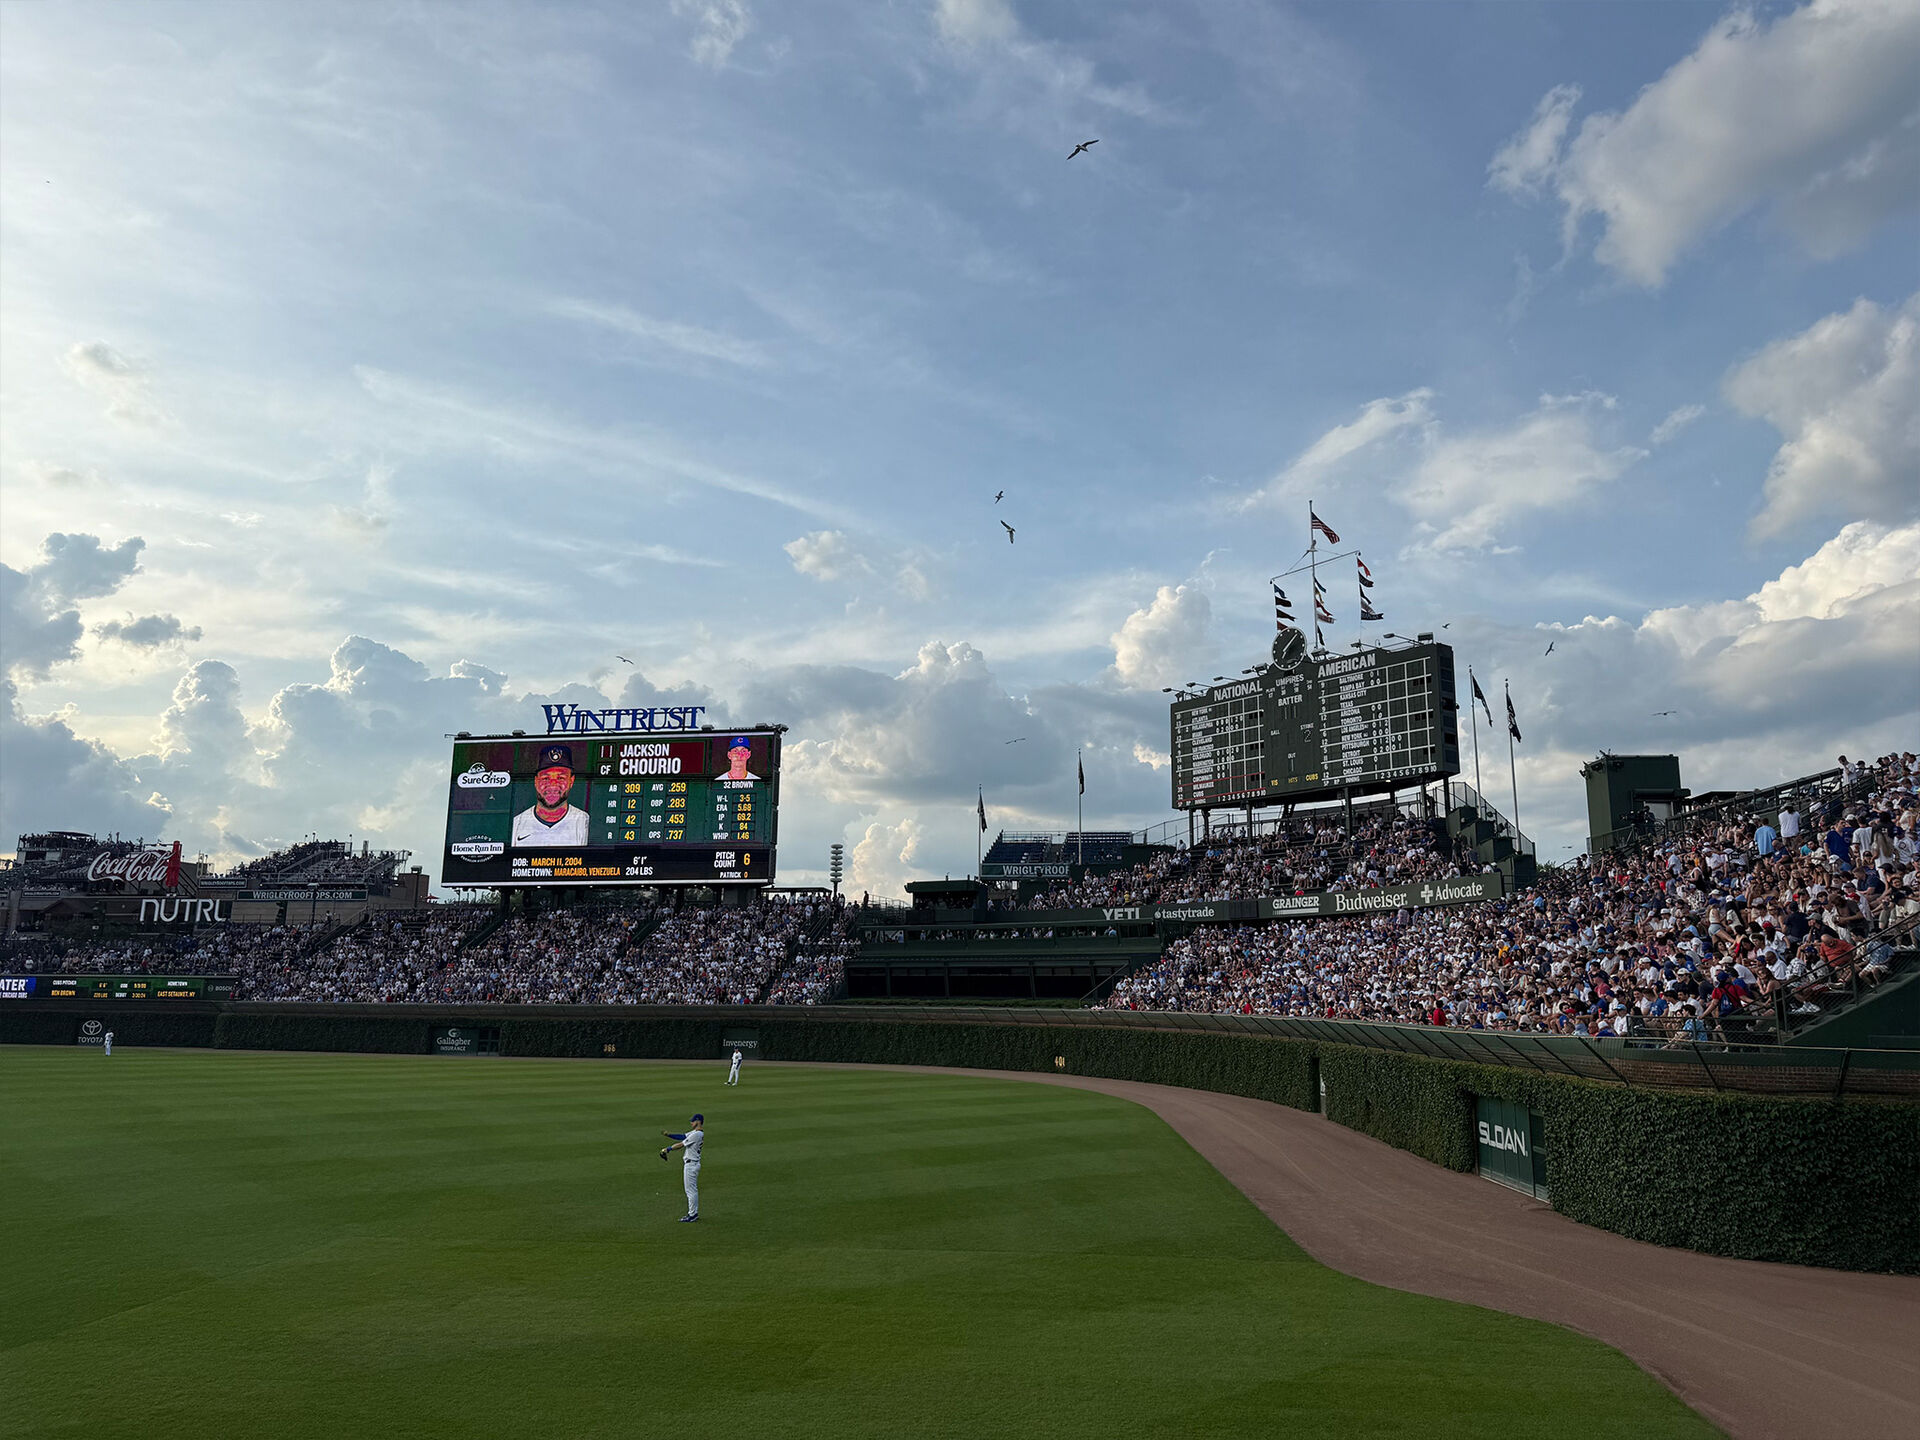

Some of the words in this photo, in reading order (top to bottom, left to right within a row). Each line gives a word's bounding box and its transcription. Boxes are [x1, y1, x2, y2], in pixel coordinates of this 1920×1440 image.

[1318, 653, 1376, 678] AMERICAN
[1276, 674, 1304, 687] UMPIRES
[1214, 680, 1263, 702] NATIONAL
[1340, 683, 1354, 692] TAMPA
[1355, 681, 1365, 689] BAY
[1278, 694, 1302, 706] BATTER
[1340, 692, 1356, 701] KANSAS
[1357, 689, 1367, 697] CITY
[1340, 700, 1353, 709] TEXAS
[1341, 707, 1360, 717] ARIZONA
[541, 703, 706, 733] WINTRUST
[1341, 715, 1362, 725] TORONTO
[1303, 729, 1311, 743] 2
[1342, 733, 1350, 743] NEW
[1351, 732, 1362, 741] YORK
[601, 745, 613, 758] 11
[620, 743, 669, 758] JACKSON
[1342, 749, 1360, 759] DETROIT
[619, 757, 681, 775] CHOURIO
[1342, 760, 1350, 768] ST.
[1350, 757, 1363, 767] LOUIS
[600, 764, 612, 775] CF
[1342, 766, 1362, 776] CHICAGO
[1404, 768, 1410, 776] 6
[1411, 767, 1416, 775] 7
[1418, 766, 1423, 774] 8
[1424, 765, 1430, 773] 9
[1430, 764, 1437, 773] 10
[1305, 773, 1319, 781] CUBS
[609, 784, 618, 792] AB
[625, 783, 641, 793] 309
[652, 783, 664, 791] AVG
[668, 782, 687, 793] .259
[723, 781, 731, 789] 32
[732, 780, 754, 789] BROWN
[716, 794, 729, 802] W-L
[739, 794, 751, 802] 3-5
[1192, 789, 1204, 798] CUBS
[1260, 789, 1266, 797] 10
[608, 800, 617, 808] HR
[628, 799, 636, 809] 12
[650, 799, 663, 807] OBP
[667, 798, 686, 808] .283
[605, 815, 617, 824] RBI
[625, 814, 636, 824] 42
[649, 815, 662, 823] SLG
[666, 814, 685, 824] .453
[718, 813, 725, 821] IP
[718, 822, 724, 830] K
[739, 822, 748, 831] 84
[607, 831, 613, 840] R
[624, 830, 635, 841] 43
[648, 831, 661, 839] OPS
[665, 830, 684, 840] .737
[712, 832, 729, 840] WHIP
[453, 844, 474, 853] Home
[474, 844, 489, 853] Run
[489, 844, 502, 852] Inn
[713, 859, 736, 868] COUNT
[743, 852, 751, 866] 6
[715, 851, 735, 860] PITCH
[88, 851, 176, 882] Coca-Cola
[512, 857, 528, 867] DOB:
[531, 857, 556, 867] MARCH
[564, 857, 583, 866] 2004
[511, 867, 553, 877] HOMETOWN:
[588, 866, 621, 876] VENEZUELA
[625, 866, 639, 876] 204
[639, 866, 653, 875] LBS
[719, 871, 741, 879] PATRICK
[1435, 881, 1484, 902] Advocate
[1272, 896, 1319, 909] GRAINGER
[1334, 890, 1407, 912] Budweiser
[1102, 907, 1140, 920] YETI
[1161, 905, 1216, 921] tastytrade
[436, 1037, 472, 1047] Gallagher
[723, 1039, 758, 1049] Invenergy
[1478, 1120, 1526, 1157] SLOAN
